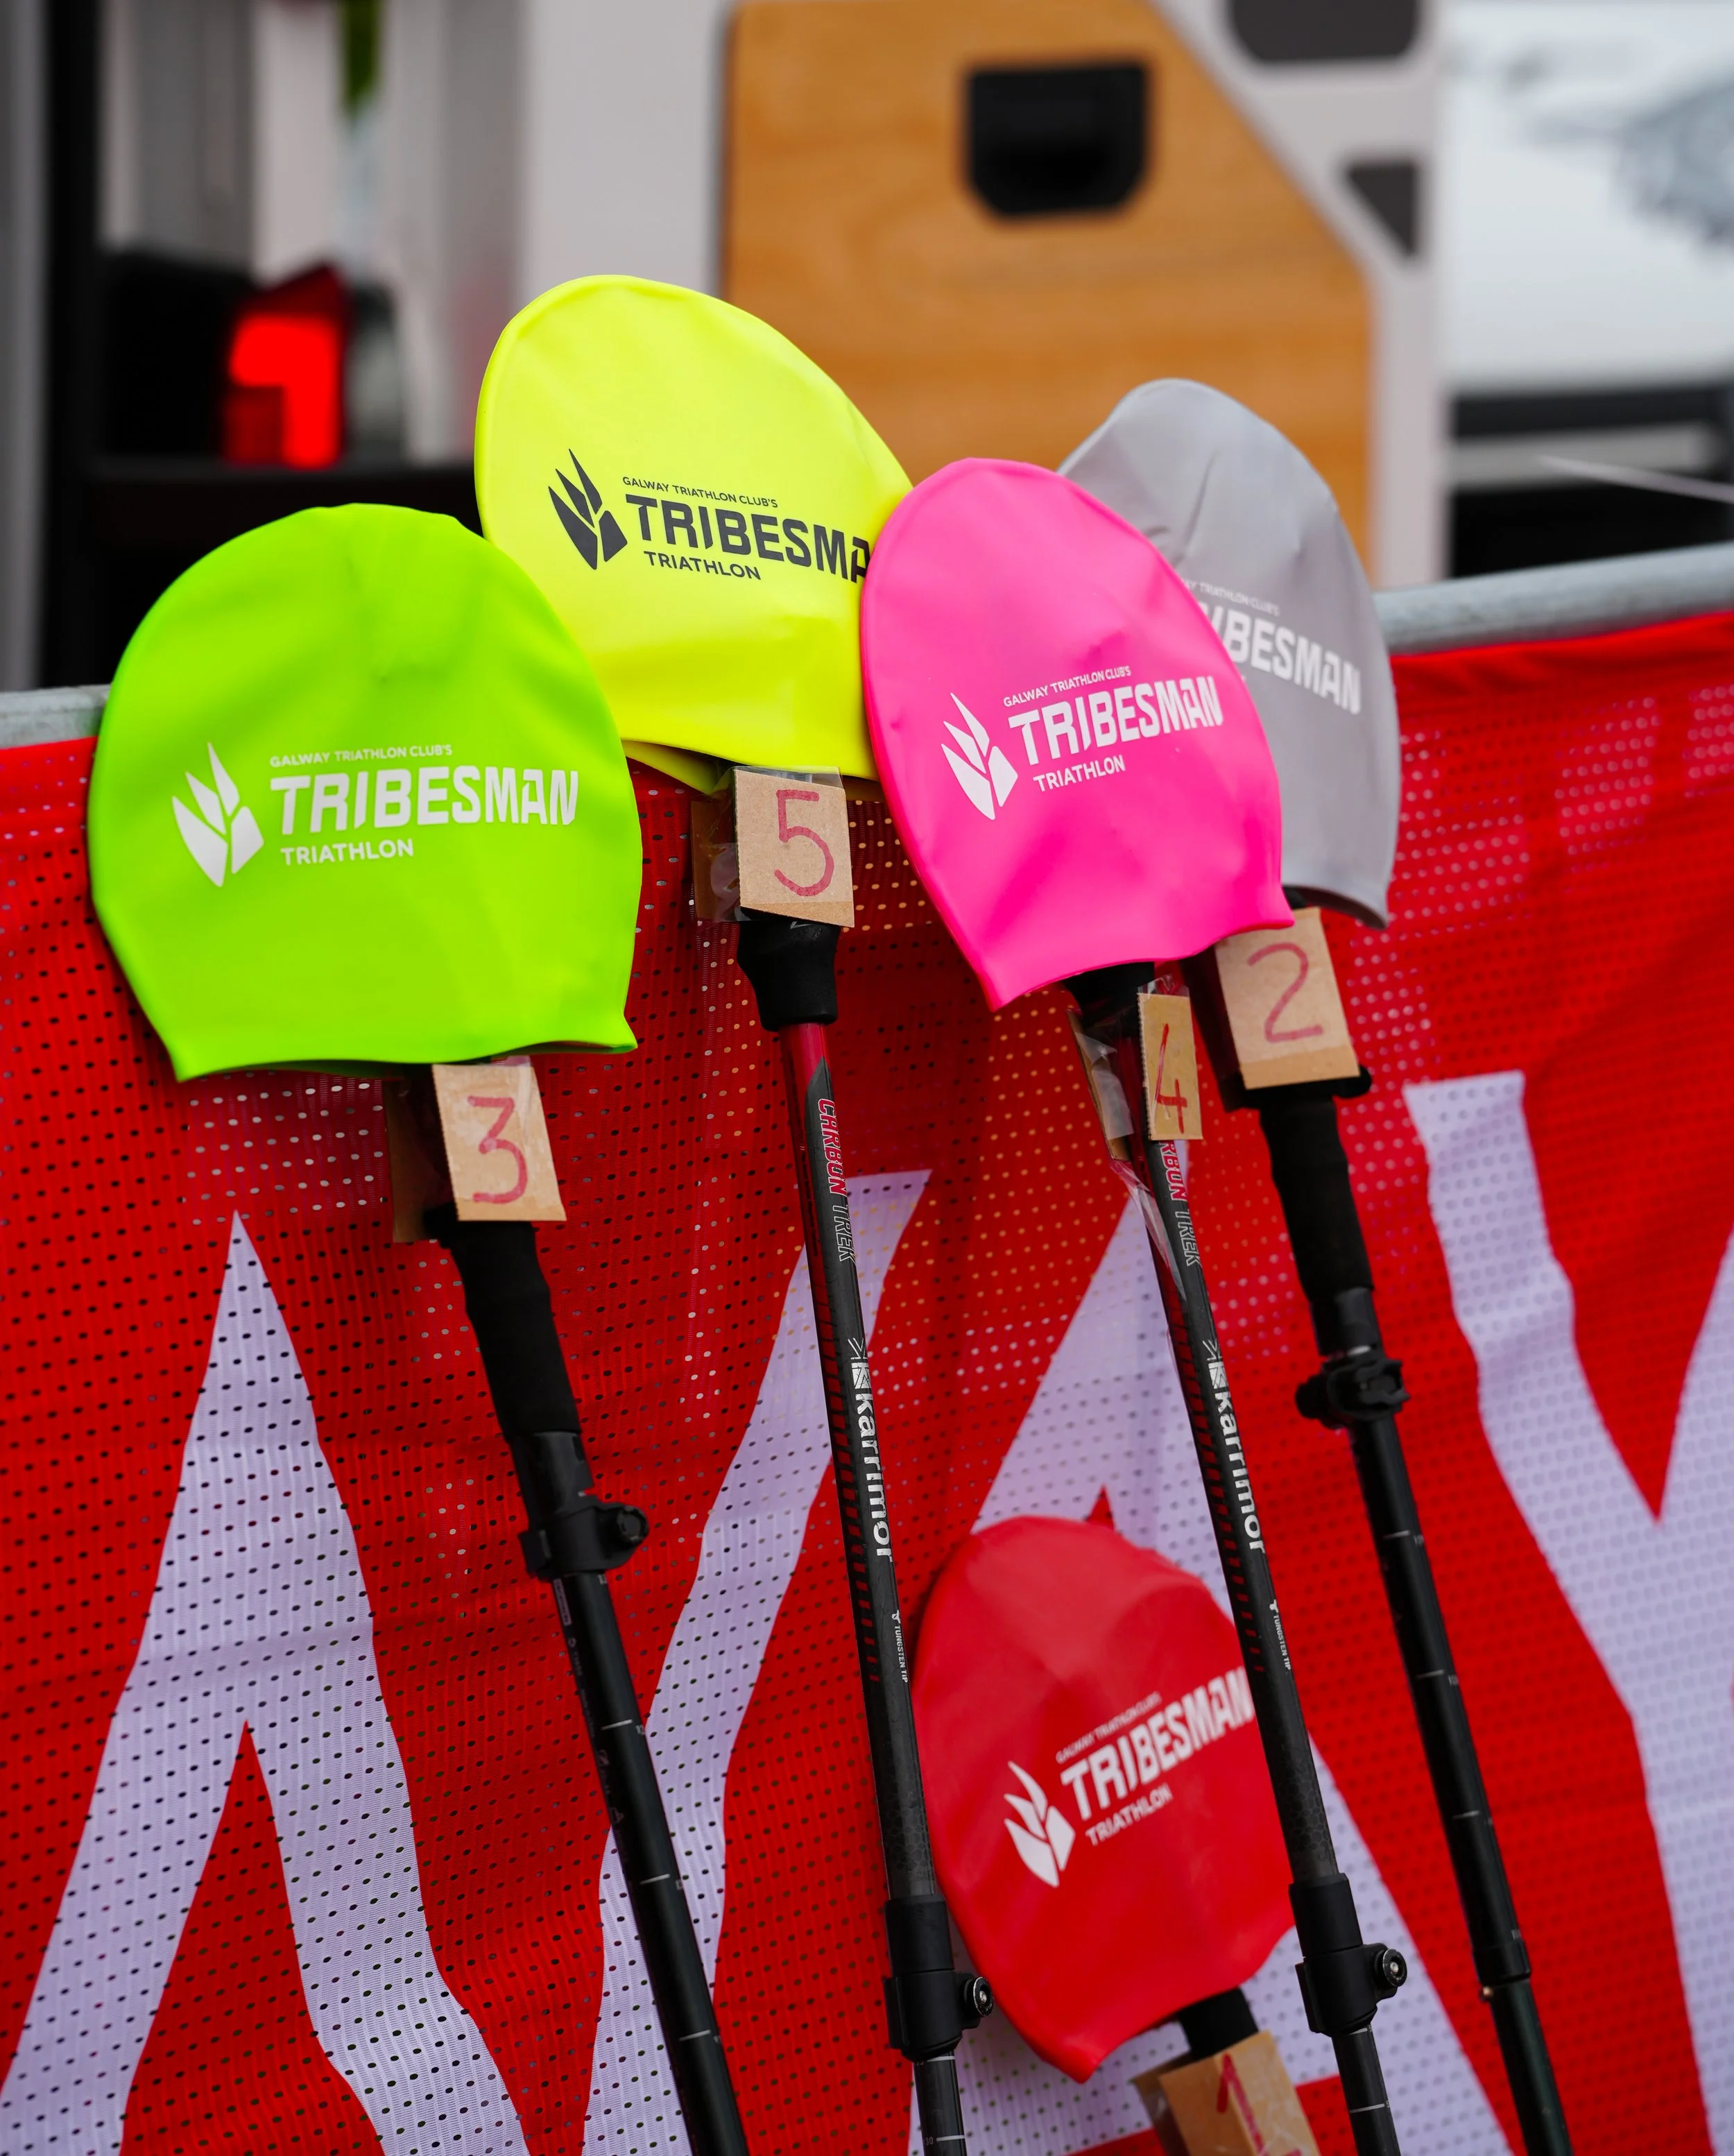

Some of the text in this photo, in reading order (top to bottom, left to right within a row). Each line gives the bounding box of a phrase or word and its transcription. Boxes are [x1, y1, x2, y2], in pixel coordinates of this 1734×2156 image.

[622, 476, 779, 508] GALWAY TRIATHLON CLUB'S
[625, 493, 873, 584] TRIBESMA
[644, 550, 762, 581] TRIATHLON
[1003, 666, 1131, 708] GALWAY TRIATHLON CLUB'S
[1198, 601, 1361, 715] IBESMAN
[269, 744, 453, 769] GALWAY TRIATHLON CLUB'S
[1008, 676, 1224, 766] TRIBESMAN
[270, 764, 578, 835] TRIBESMAN
[1033, 754, 1126, 792] TRIATHLON
[280, 838, 415, 866] TRIATHLON
[774, 789, 834, 896] 5
[1248, 942, 1323, 1044] 2
[1154, 1023, 1188, 1133] 4
[467, 1095, 528, 1204] 3
[818, 1098, 857, 1266] CARBON TREK
[1175, 1208, 1201, 1268] TREK
[855, 1393, 893, 1563] karrimor
[1214, 1392, 1266, 1555] karrimor
[894, 1625, 905, 1668] TUNGSTEN
[1273, 1614, 1288, 1656] TUNGSTEN
[1060, 1666, 1256, 1822] TRIBESMAN
[1085, 1781, 1174, 1847] TRIATHLON
[1216, 2052, 1303, 2156] 1
